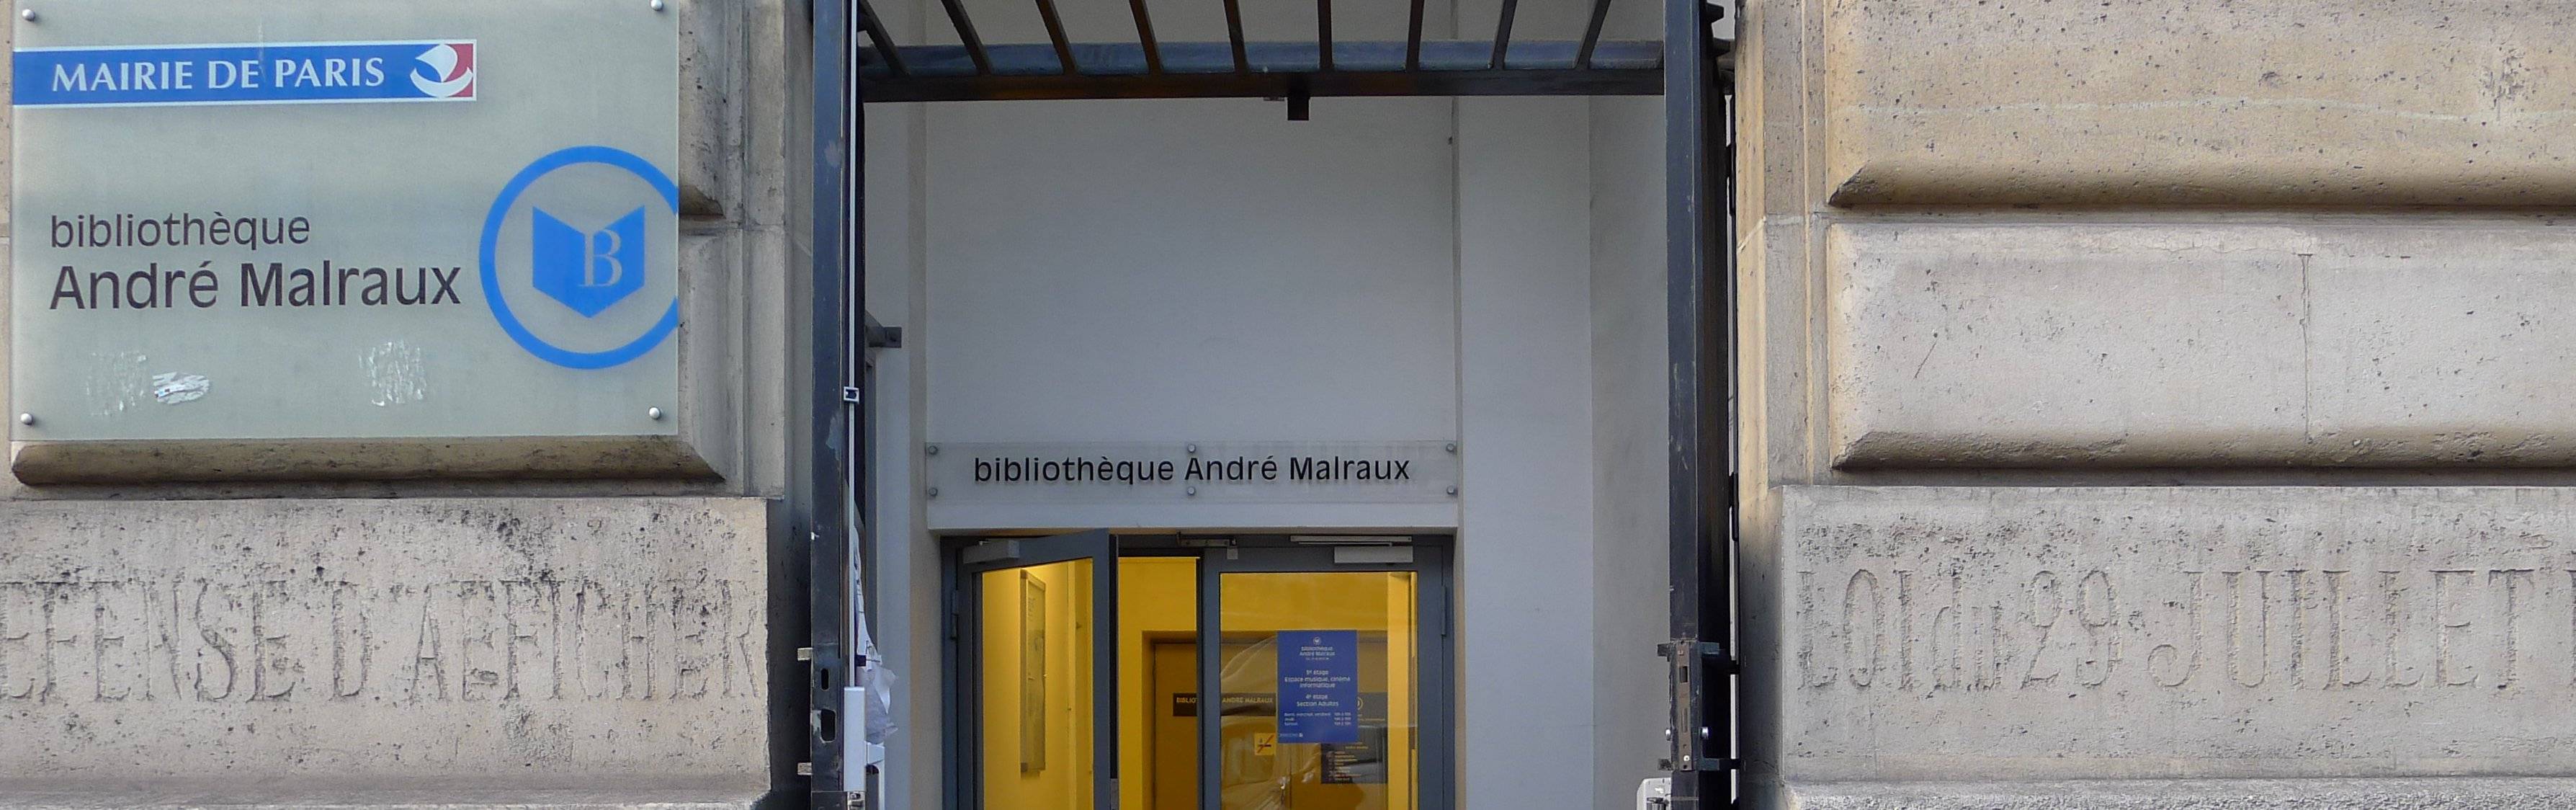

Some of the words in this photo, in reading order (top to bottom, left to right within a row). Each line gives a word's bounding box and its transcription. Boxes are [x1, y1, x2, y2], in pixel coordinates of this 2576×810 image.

[53, 62, 192, 91] MAIRIE
[209, 61, 259, 88] DE
[274, 58, 384, 86] PARIS
[51, 212, 310, 251] bibliothèque
[50, 261, 218, 310] André
[241, 260, 461, 307] Malraux
[975, 457, 1173, 486] bibliothèque
[1184, 454, 1277, 481] André
[1290, 455, 1410, 481] Malraux
[2147, 569, 2535, 692] JUILLET
